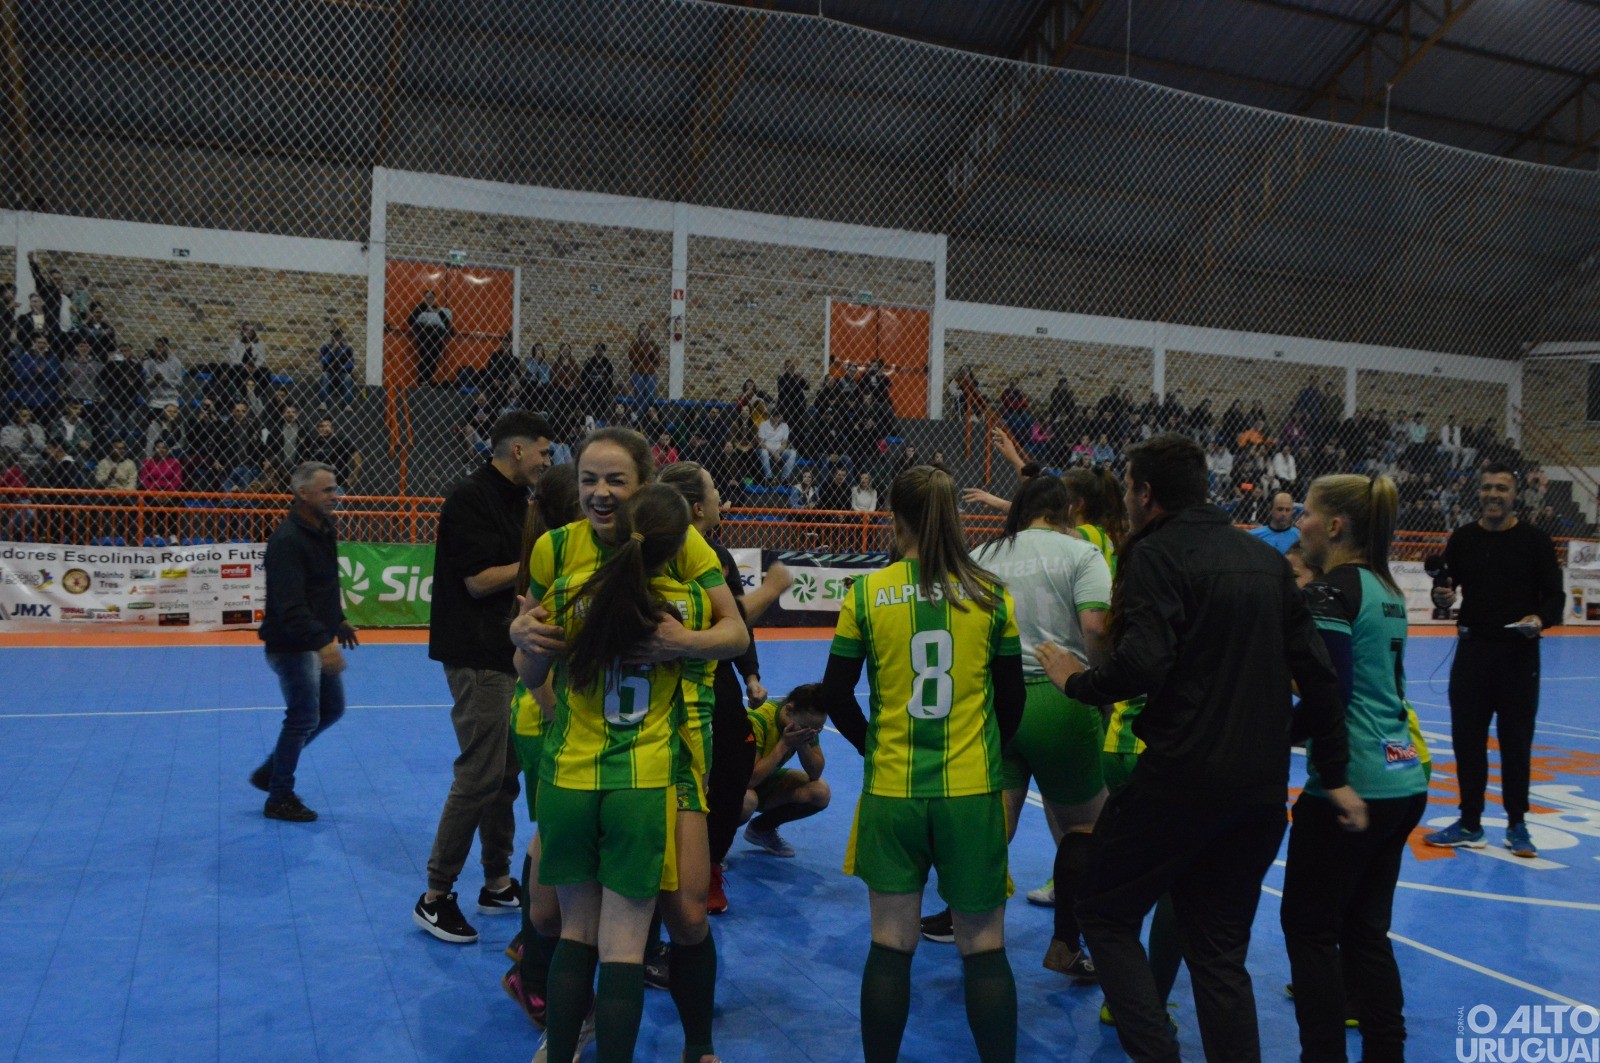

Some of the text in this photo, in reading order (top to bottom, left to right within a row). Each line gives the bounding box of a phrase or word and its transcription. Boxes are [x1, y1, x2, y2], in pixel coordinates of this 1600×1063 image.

[0, 547, 57, 561] dores
[64, 550, 155, 564] Escolinha
[161, 552, 222, 563] Rodeio
[94, 570, 125, 579] Moinho
[99, 580, 119, 589] Tres
[11, 603, 52, 617] JMX
[908, 630, 952, 718] 8
[604, 656, 651, 726] 6
